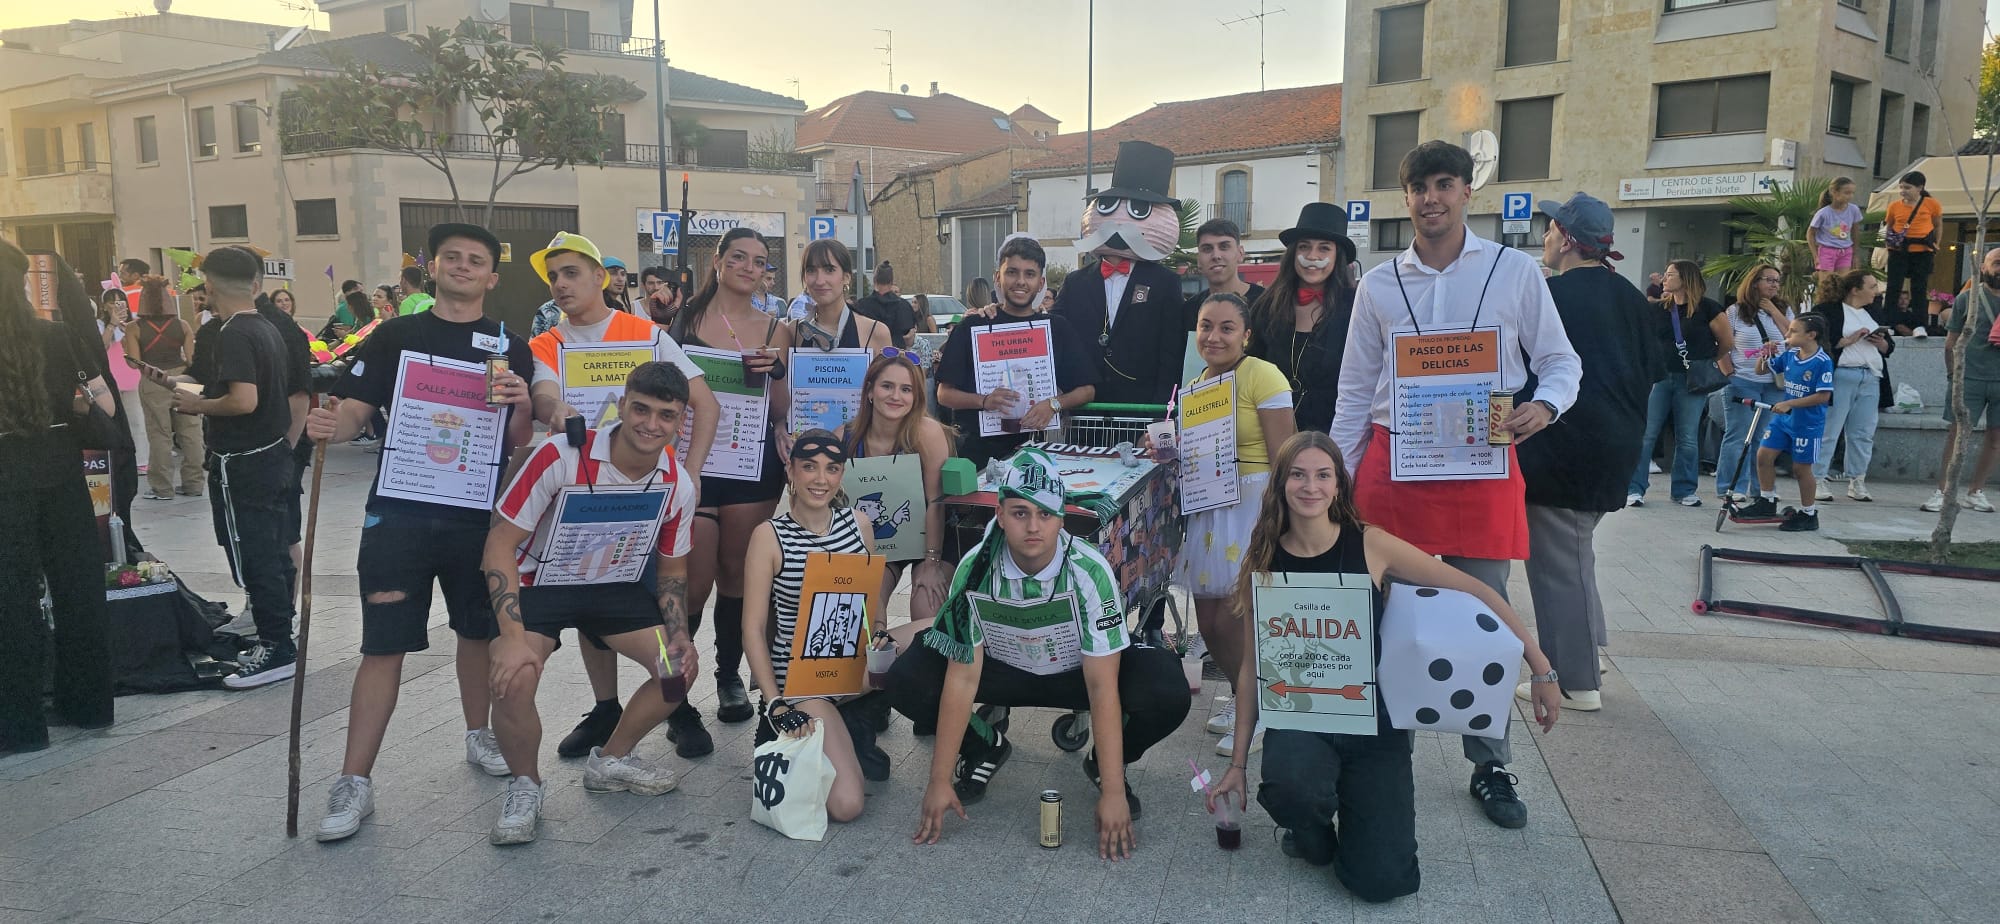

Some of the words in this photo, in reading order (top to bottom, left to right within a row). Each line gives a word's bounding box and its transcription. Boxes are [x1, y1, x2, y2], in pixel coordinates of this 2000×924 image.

[1662, 177, 1697, 187] CENTRO
[1701, 177, 1713, 185] DE
[1716, 175, 1746, 184] SALUD
[1666, 187, 1714, 196] Periurbana
[1716, 186, 1740, 194] Norte
[1351, 203, 1365, 220] P
[1509, 196, 1526, 217] P
[815, 220, 830, 240] P
[263, 262, 286, 276] LLA
[1008, 337, 1033, 345] URBAN
[999, 348, 1027, 356] BARBER
[1410, 346, 1444, 356] PASEO
[1447, 345, 1461, 354] DE
[1464, 343, 1484, 353] LAS
[583, 361, 637, 370] CARRETERA
[815, 365, 846, 373] PISCINA
[1422, 359, 1469, 369] DELICIAS
[591, 374, 603, 382] LA
[605, 374, 626, 382] MAT
[808, 377, 853, 385] MUNICIPAL
[416, 382, 446, 395] CALLE
[1186, 407, 1202, 418] CALLE
[1203, 397, 1228, 412] ESTRELLA
[1491, 403, 1503, 438] 1906
[1160, 440, 1172, 448] PRO
[833, 577, 852, 585] SOLO
[1294, 603, 1318, 611] Casilla
[1321, 603, 1331, 611] de
[1268, 616, 1361, 640] SALIDA
[1305, 653, 1328, 661] 200€
[1331, 654, 1351, 662] cada
[815, 671, 838, 679] VISITAS
[755, 752, 789, 811] $
